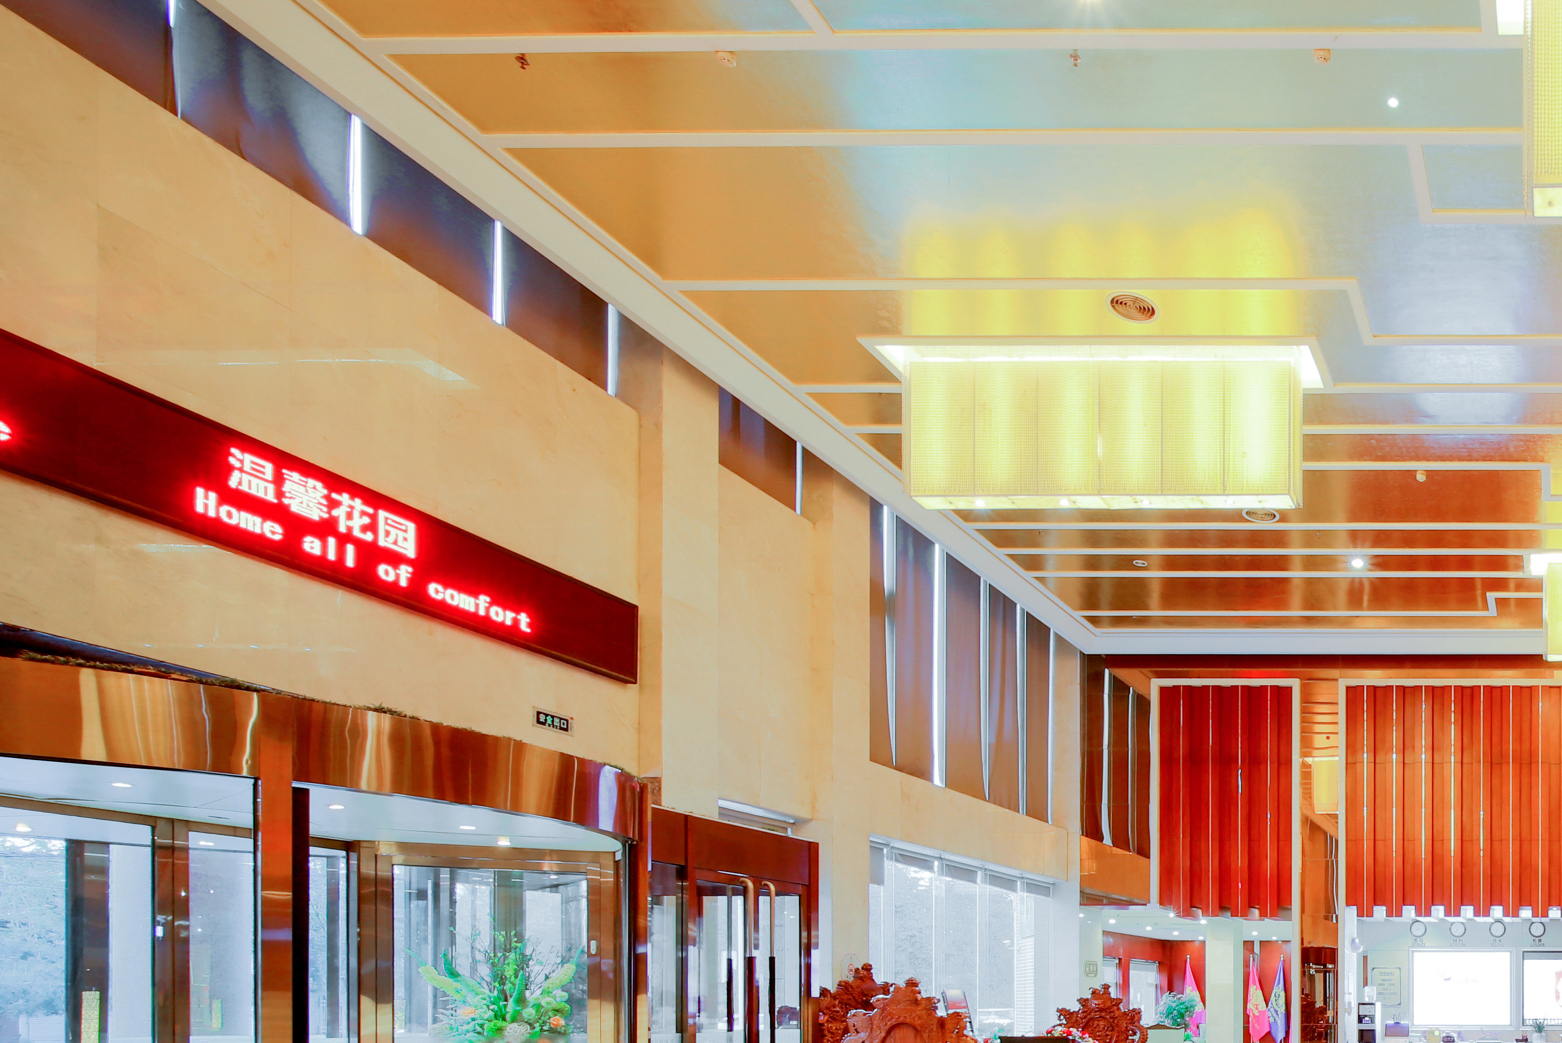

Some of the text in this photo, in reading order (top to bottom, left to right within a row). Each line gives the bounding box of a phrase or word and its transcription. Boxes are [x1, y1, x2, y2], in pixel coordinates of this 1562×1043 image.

[194, 486, 532, 633] Home all of comfort
[227, 446, 416, 560] 温馨花园
